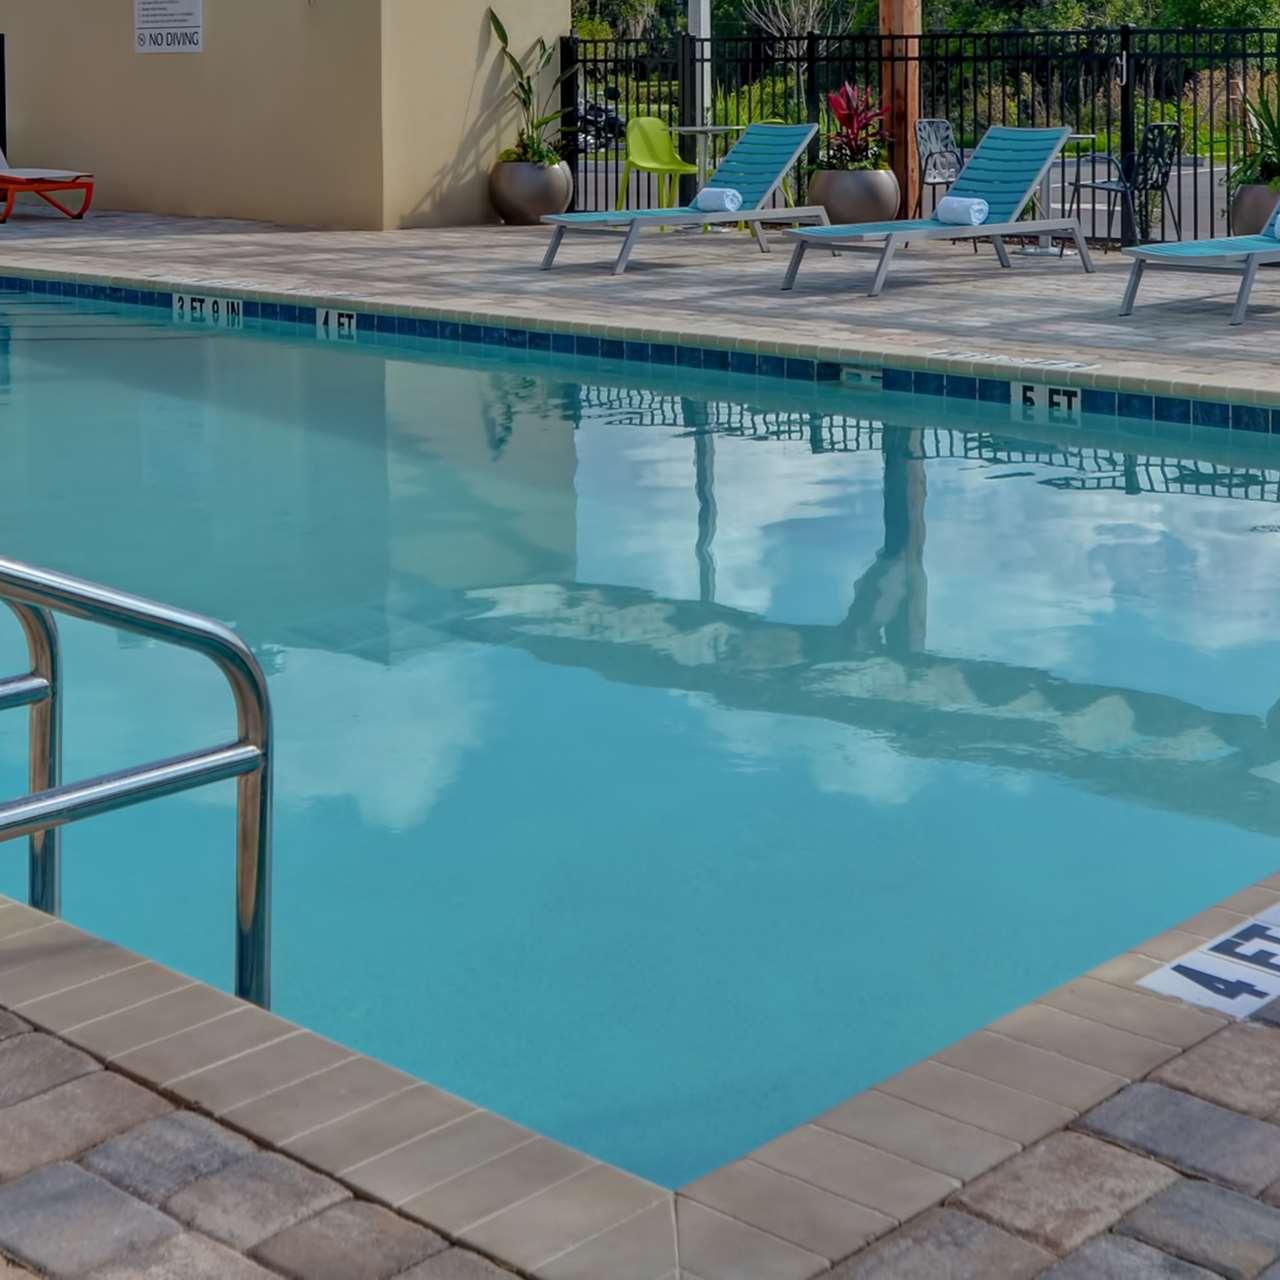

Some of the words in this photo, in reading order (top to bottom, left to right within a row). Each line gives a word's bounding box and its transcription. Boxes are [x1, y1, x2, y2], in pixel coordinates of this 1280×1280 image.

[149, 33, 164, 46] NO
[166, 32, 199, 46] DIVING
[1048, 388, 1079, 412] FT
[1170, 963, 1270, 1000] 4
